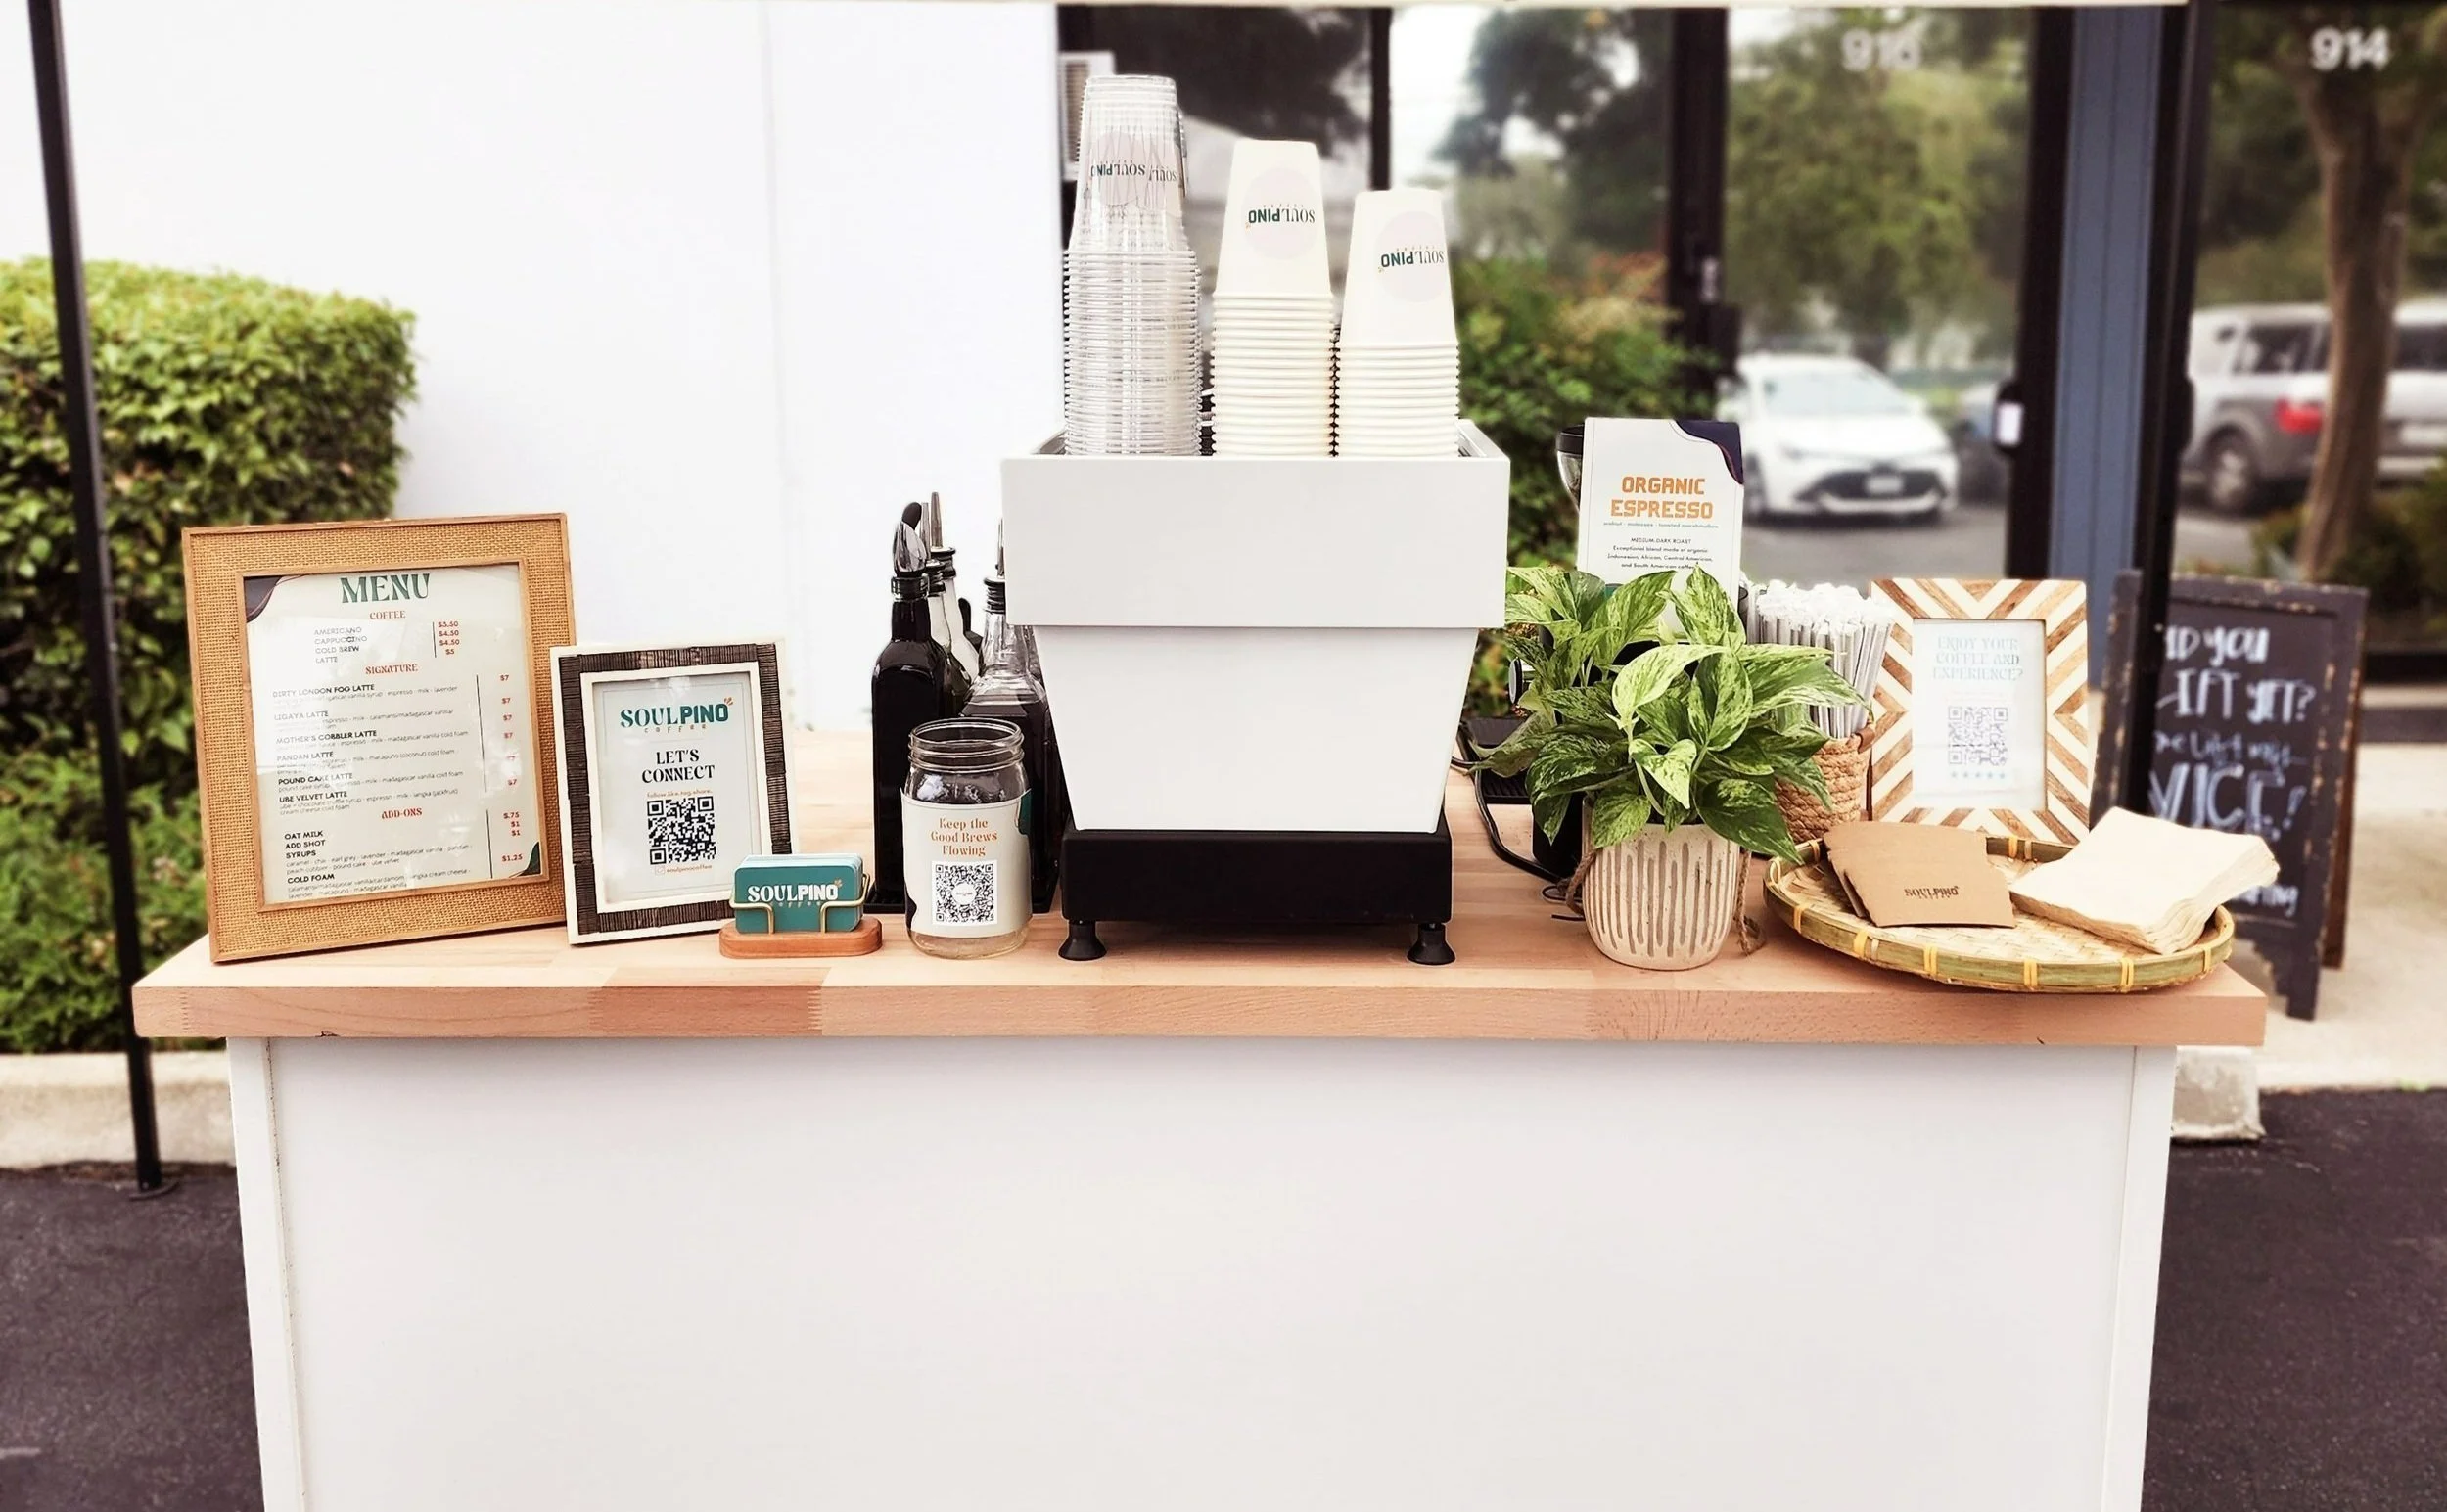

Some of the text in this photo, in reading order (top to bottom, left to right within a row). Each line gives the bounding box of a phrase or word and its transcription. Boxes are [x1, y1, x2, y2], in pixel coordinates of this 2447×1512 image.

[2311, 25, 2389, 72] 914
[1248, 208, 1316, 224] SOULPINO
[1380, 250, 1444, 268] SOULPINO
[1622, 476, 1706, 495] ORGANIC
[1610, 500, 1713, 519] ESPRESSO
[340, 573, 431, 603] MENU
[369, 610, 406, 620] COFFEE
[314, 626, 362, 635] AMERICANO
[314, 636, 368, 645] CAPPUCCINO
[1937, 637, 2018, 651] ENJOY YOUR
[2163, 625, 2200, 660] ID
[1936, 652, 2019, 666] COFFEE AND
[365, 664, 418, 675] SIGNATURE
[1933, 667, 2024, 681] EXPERIENCE?
[272, 689, 297, 698] DIRTY
[299, 687, 332, 696] LONDON
[274, 712, 304, 721] LIGAYA
[621, 703, 729, 728] SOULPINO
[276, 735, 316, 744] MOTHER'S
[318, 732, 353, 741] COBBLER
[277, 751, 334, 761] PANDAN LATTE
[656, 749, 700, 765] LET'S
[278, 776, 305, 785] POUND
[642, 765, 715, 784] CONNECT
[279, 795, 294, 803] UBE
[296, 793, 323, 802] VELVET
[381, 807, 423, 820] ADD-ONS
[940, 818, 988, 831] Keep the
[303, 830, 323, 839] MILK
[931, 831, 997, 842] Good Brews
[285, 839, 326, 849] ADD SHOT
[286, 849, 316, 859] SYRUPS
[943, 845, 986, 856] Flowing
[288, 873, 335, 884] COLD FOAM
[747, 884, 839, 902] SOULPINO
